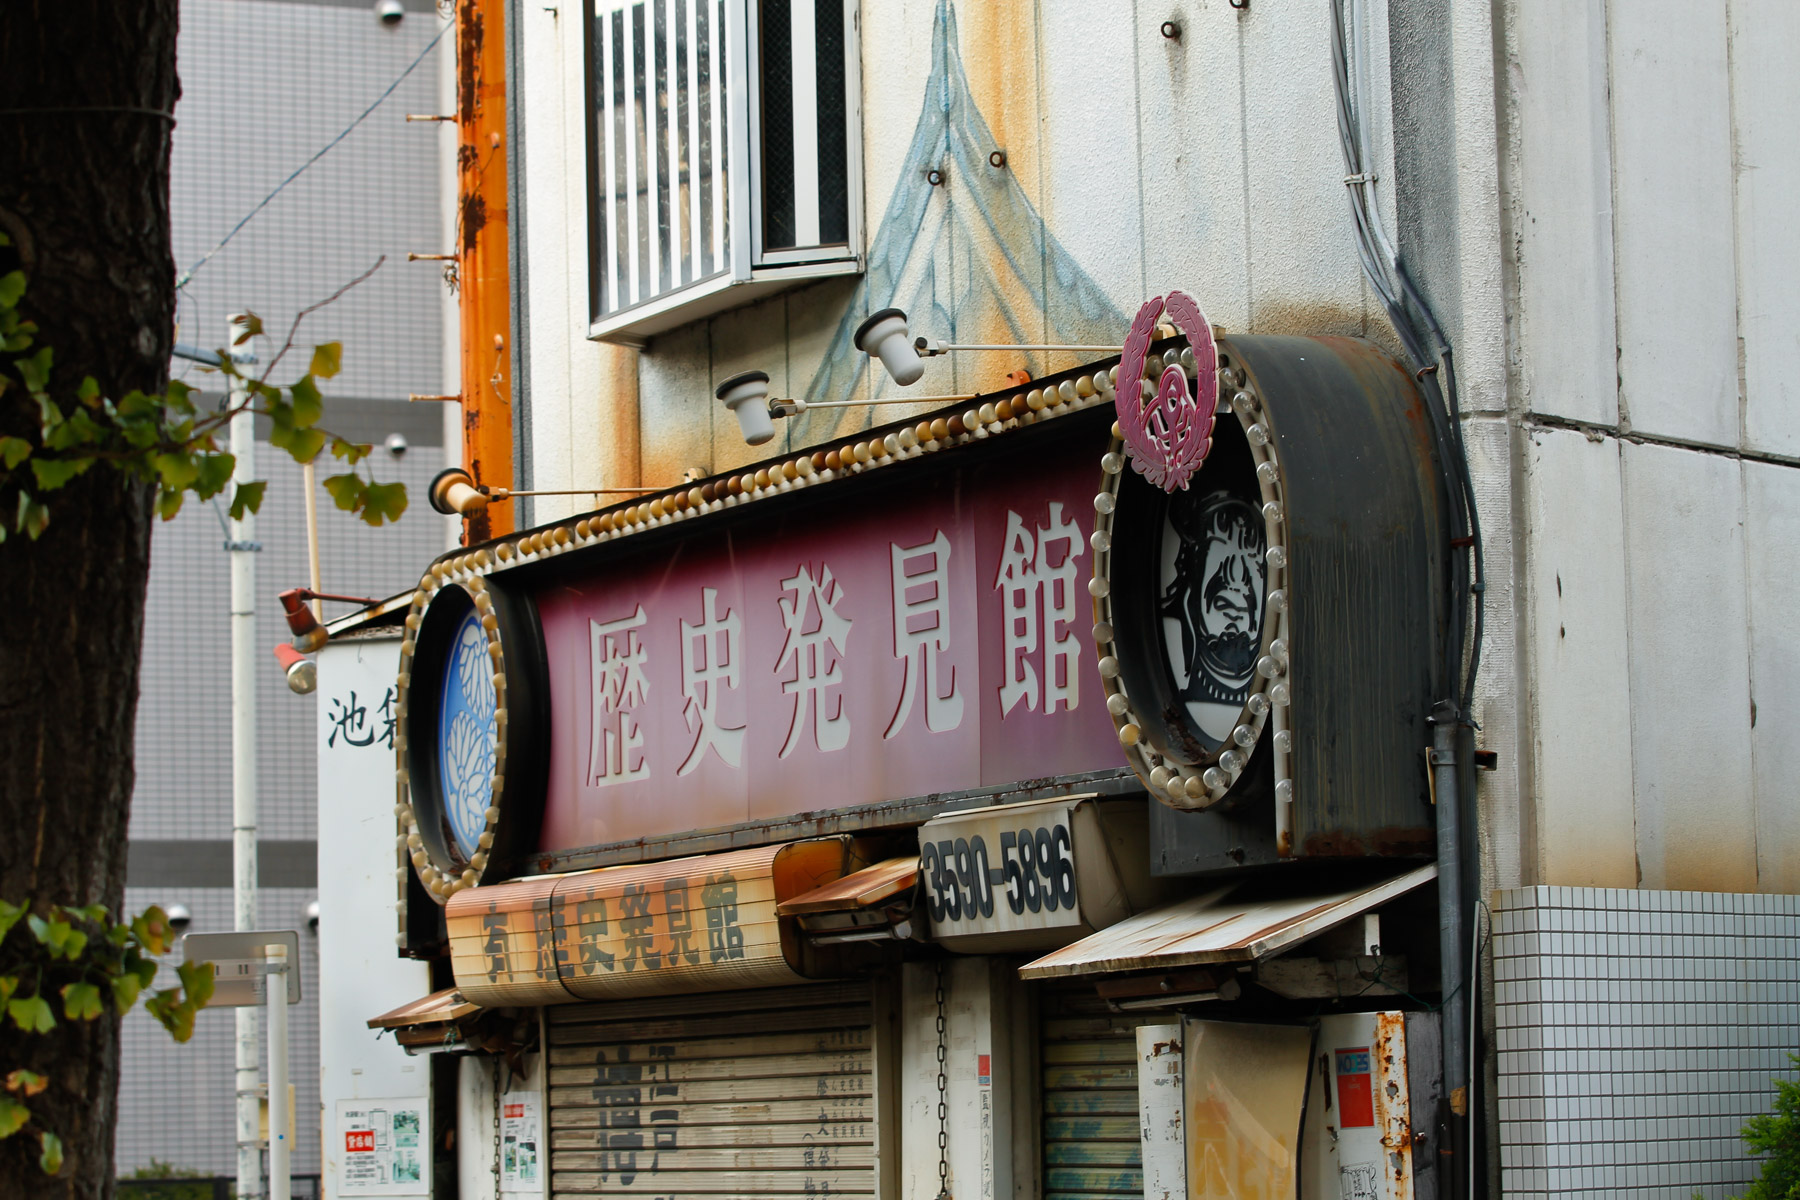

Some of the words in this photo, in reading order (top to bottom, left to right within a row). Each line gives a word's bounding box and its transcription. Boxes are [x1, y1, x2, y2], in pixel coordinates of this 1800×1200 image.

[587, 501, 1084, 787] 歴史発見館
[923, 824, 1076, 923] 3590-5896
